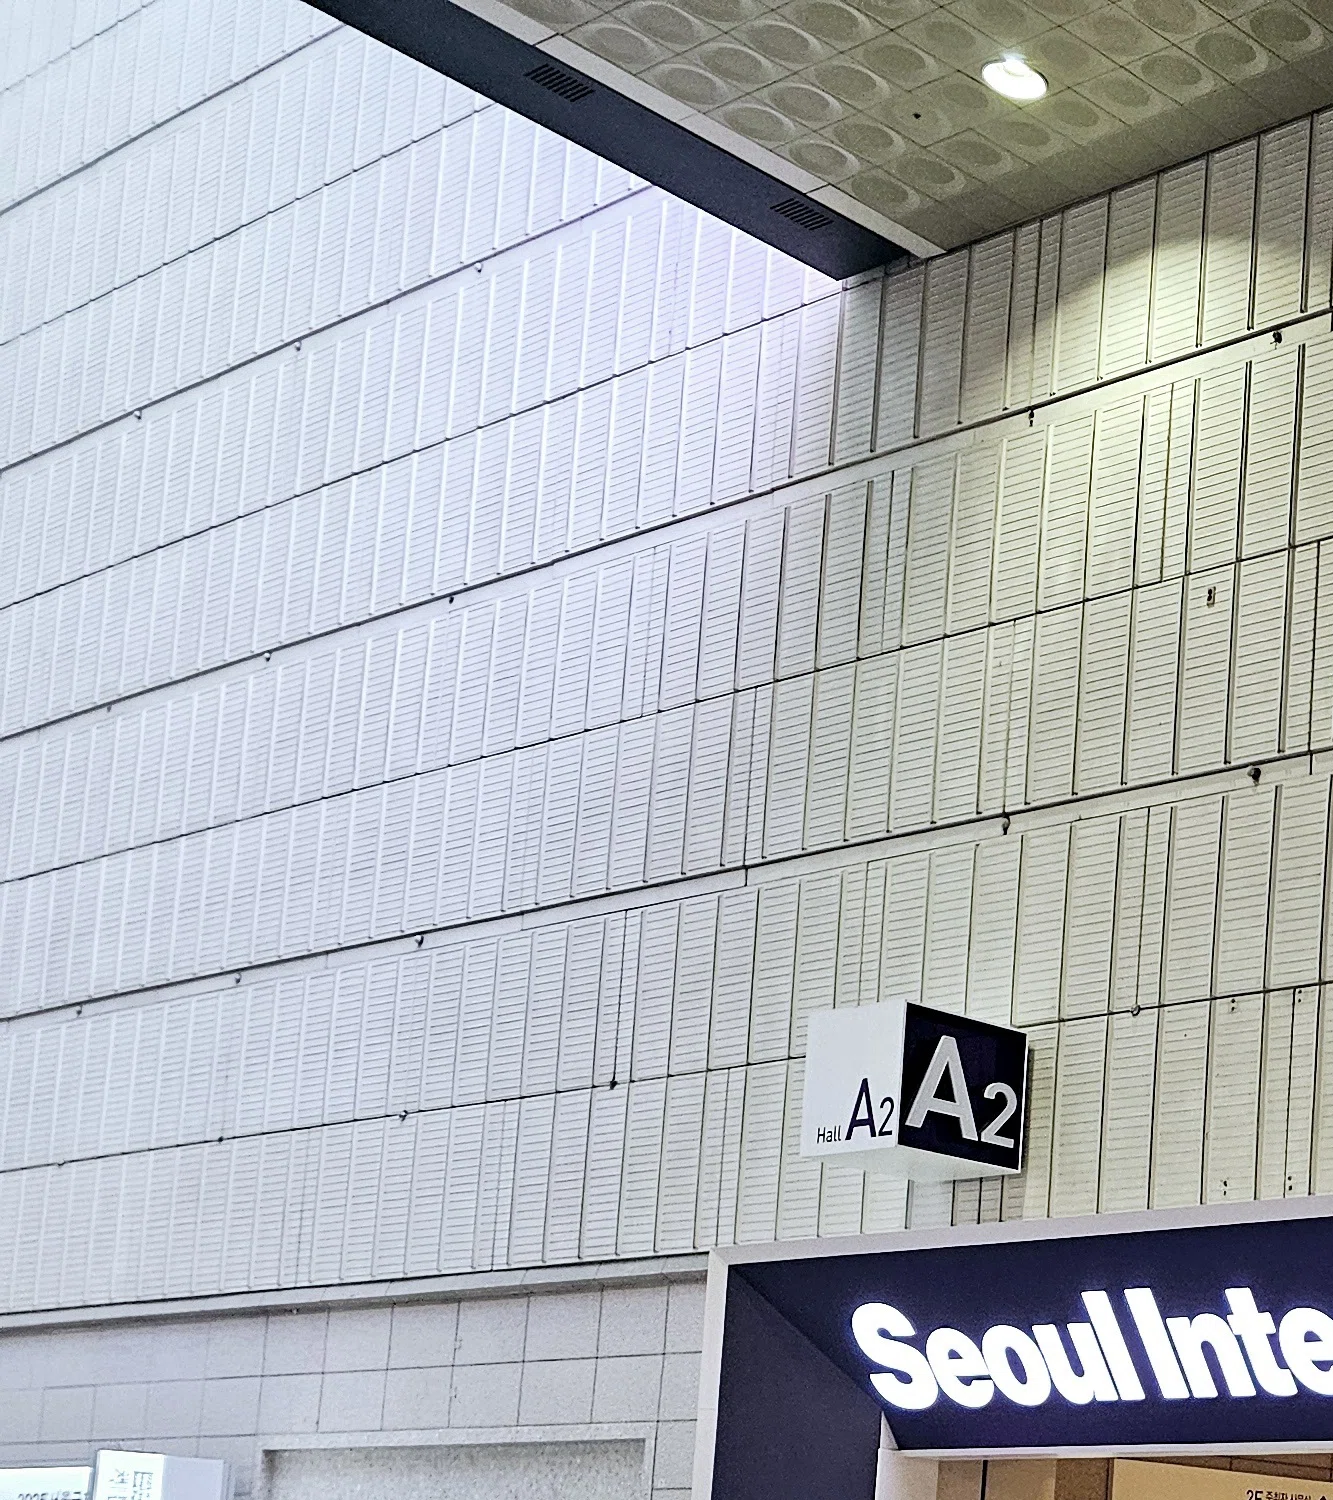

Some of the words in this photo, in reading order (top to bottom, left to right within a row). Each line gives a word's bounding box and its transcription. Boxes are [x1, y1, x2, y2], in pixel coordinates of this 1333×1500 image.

[816, 1126, 842, 1144] Hall
[844, 1077, 895, 1141] A2
[904, 1034, 1018, 1149] A2
[850, 1288, 1145, 1411] Seoul
